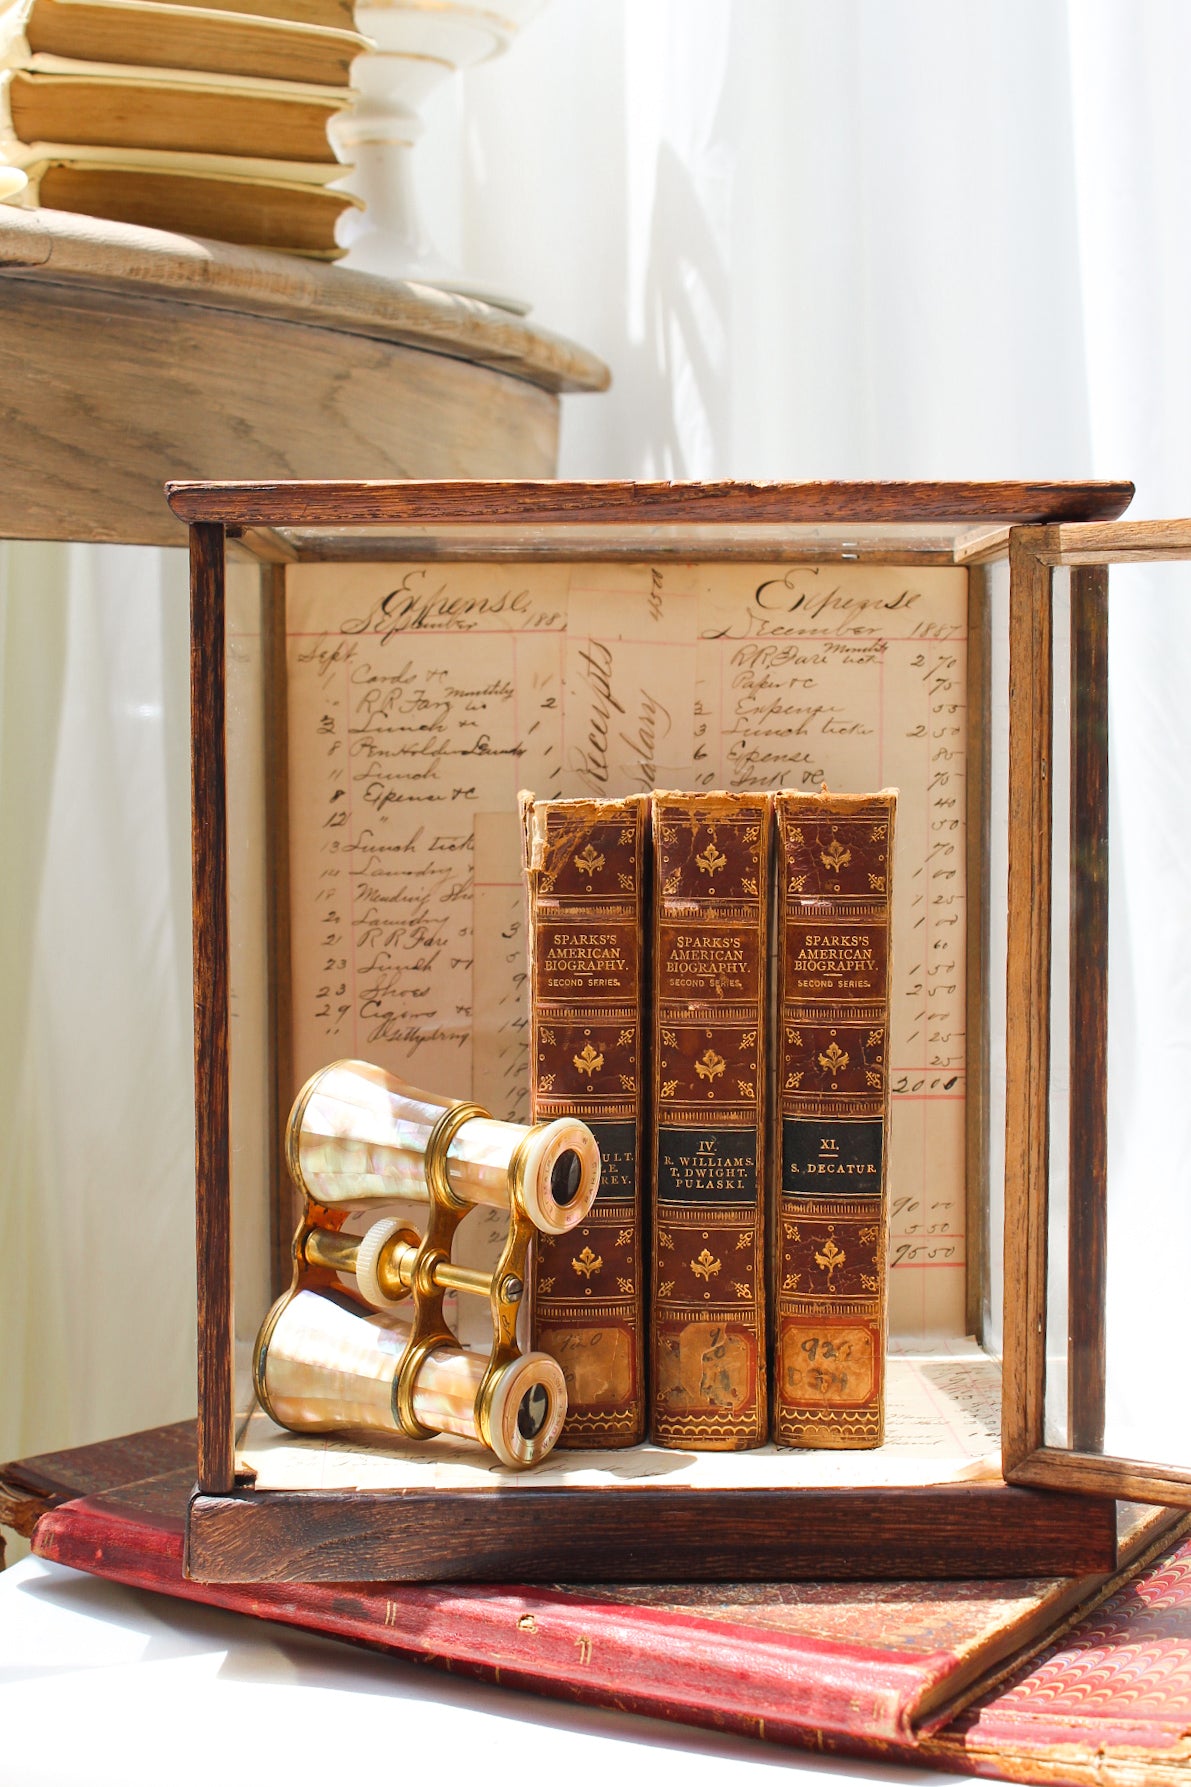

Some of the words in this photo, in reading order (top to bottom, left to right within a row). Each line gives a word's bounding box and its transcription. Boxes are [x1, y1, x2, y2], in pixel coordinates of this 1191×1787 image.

[755, 568, 921, 619] Expense
[701, 607, 882, 640] December
[909, 621, 963, 642] 1887
[910, 654, 925, 667] 2
[906, 725, 927, 738] 2
[693, 744, 708, 760] 6
[554, 934, 617, 945] SPARKS'S
[676, 935, 741, 948] SPARKS'S
[805, 935, 870, 947] SPARKS'S
[547, 948, 620, 959] AMERICAN
[670, 949, 743, 961] AMERICAN
[798, 948, 872, 960] AMERICAN
[544, 959, 629, 971] BIOGRAPHY.
[666, 961, 751, 973] BIOGRAPHY.
[794, 960, 879, 972] BIOGRAPHY.
[548, 979, 583, 987] SECOND
[588, 979, 621, 987] SERIES.
[669, 979, 705, 987] SECOND
[797, 979, 834, 988] SECOND
[838, 980, 871, 988] SERIES.
[906, 984, 922, 995] 2
[698, 1140, 717, 1152] IV.
[820, 1138, 840, 1150] XI.
[664, 1155, 674, 1166] R.
[679, 1156, 754, 1167] WILLIAMS.
[684, 1168, 748, 1178] DWIGHT.
[790, 1163, 800, 1173] S.
[675, 1179, 745, 1190] PULASKI.
